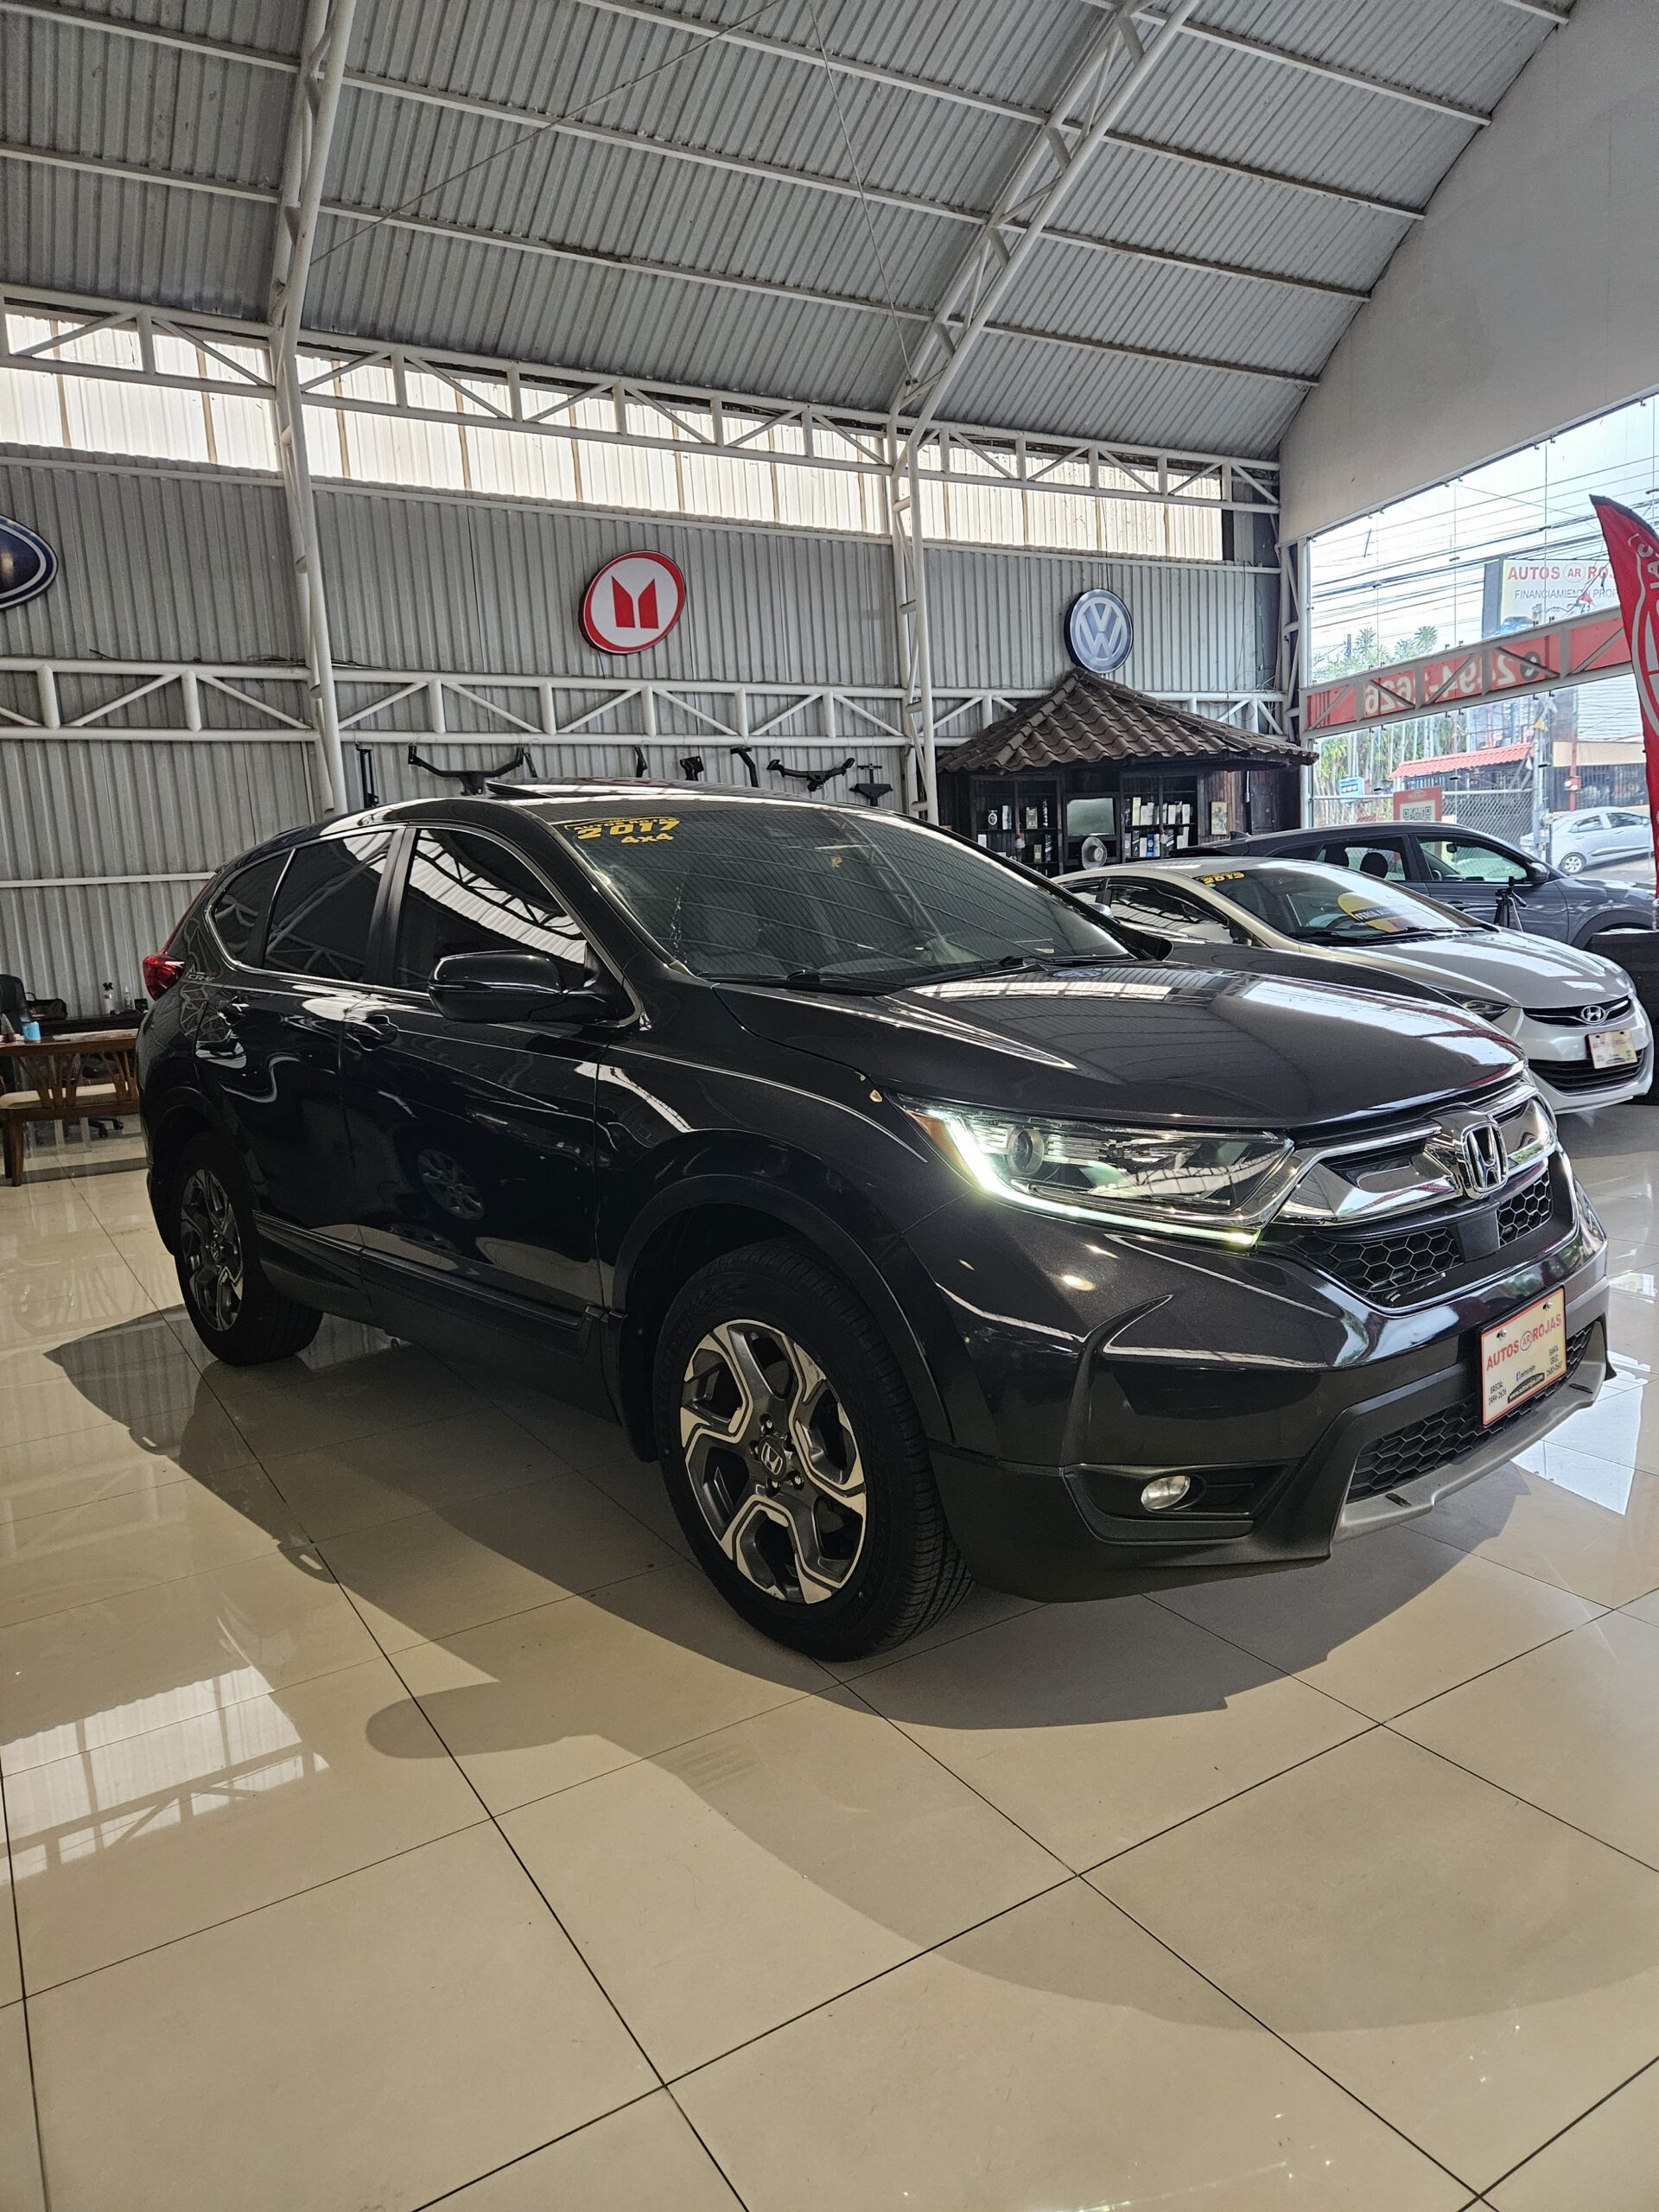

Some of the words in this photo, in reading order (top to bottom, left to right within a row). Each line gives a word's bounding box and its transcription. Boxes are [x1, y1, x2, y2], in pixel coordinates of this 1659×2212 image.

[1507, 566, 1560, 580] AUTOS
[1567, 568, 1581, 577] AR
[577, 820, 680, 839] 2017
[1486, 1340, 1519, 1371] AUTOS
[1533, 1313, 1562, 1343] ROJAS
